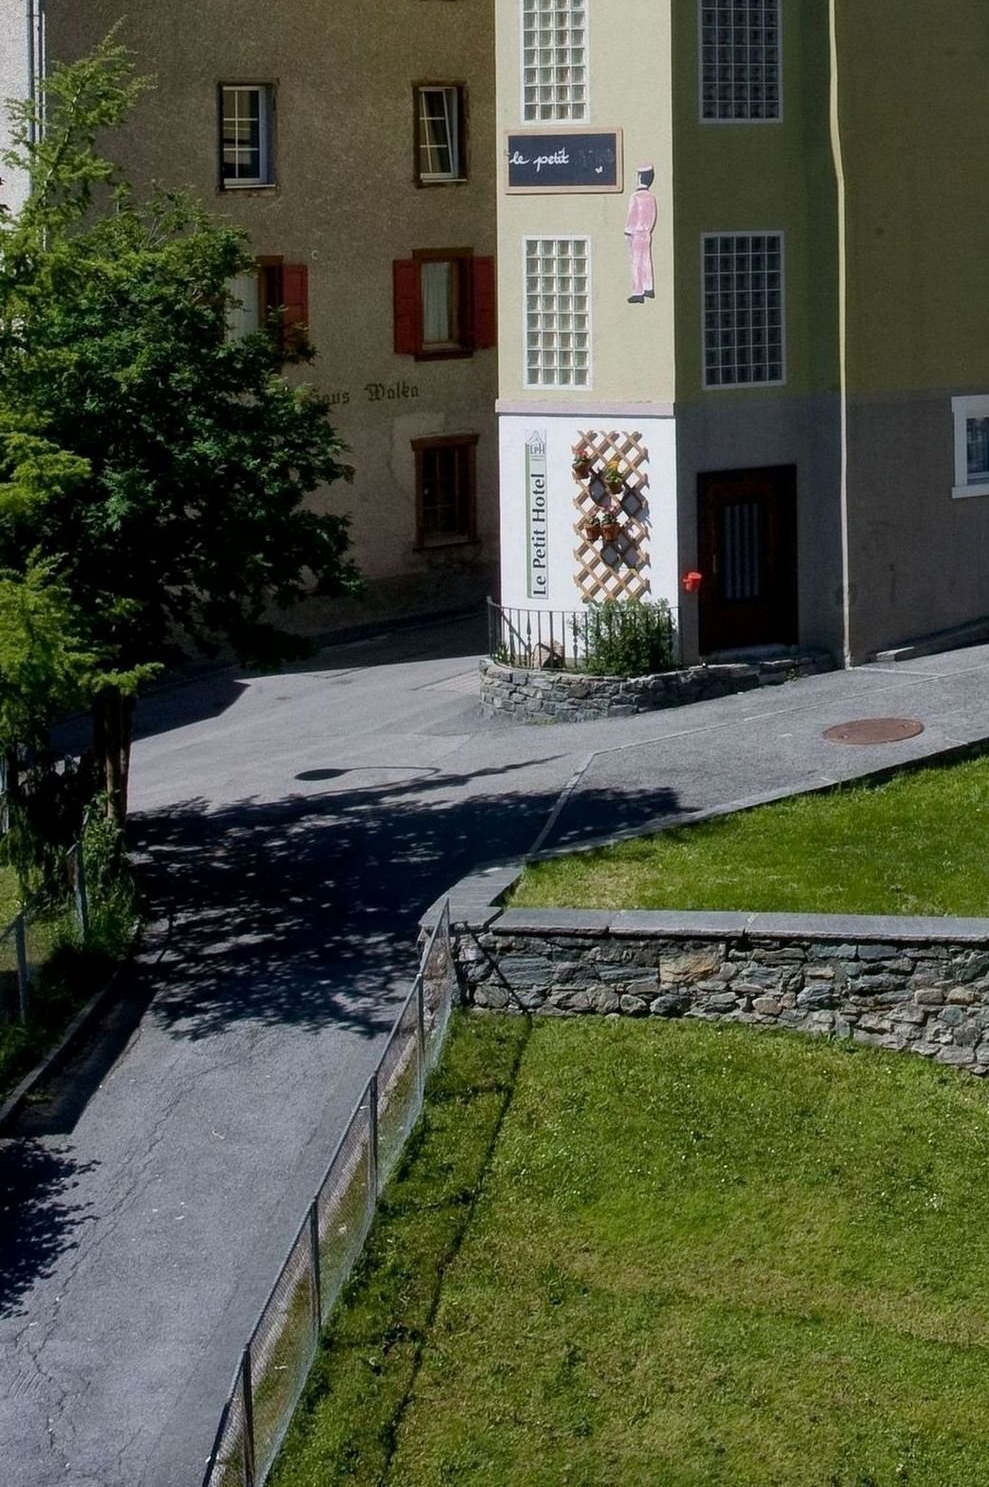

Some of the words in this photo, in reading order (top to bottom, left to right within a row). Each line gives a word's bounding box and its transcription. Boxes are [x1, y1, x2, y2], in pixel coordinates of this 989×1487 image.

[509, 151, 530, 165] le
[533, 147, 570, 173] petit
[530, 473, 545, 523] Hotel
[532, 530, 546, 570] Petit
[533, 575, 546, 595] Le
